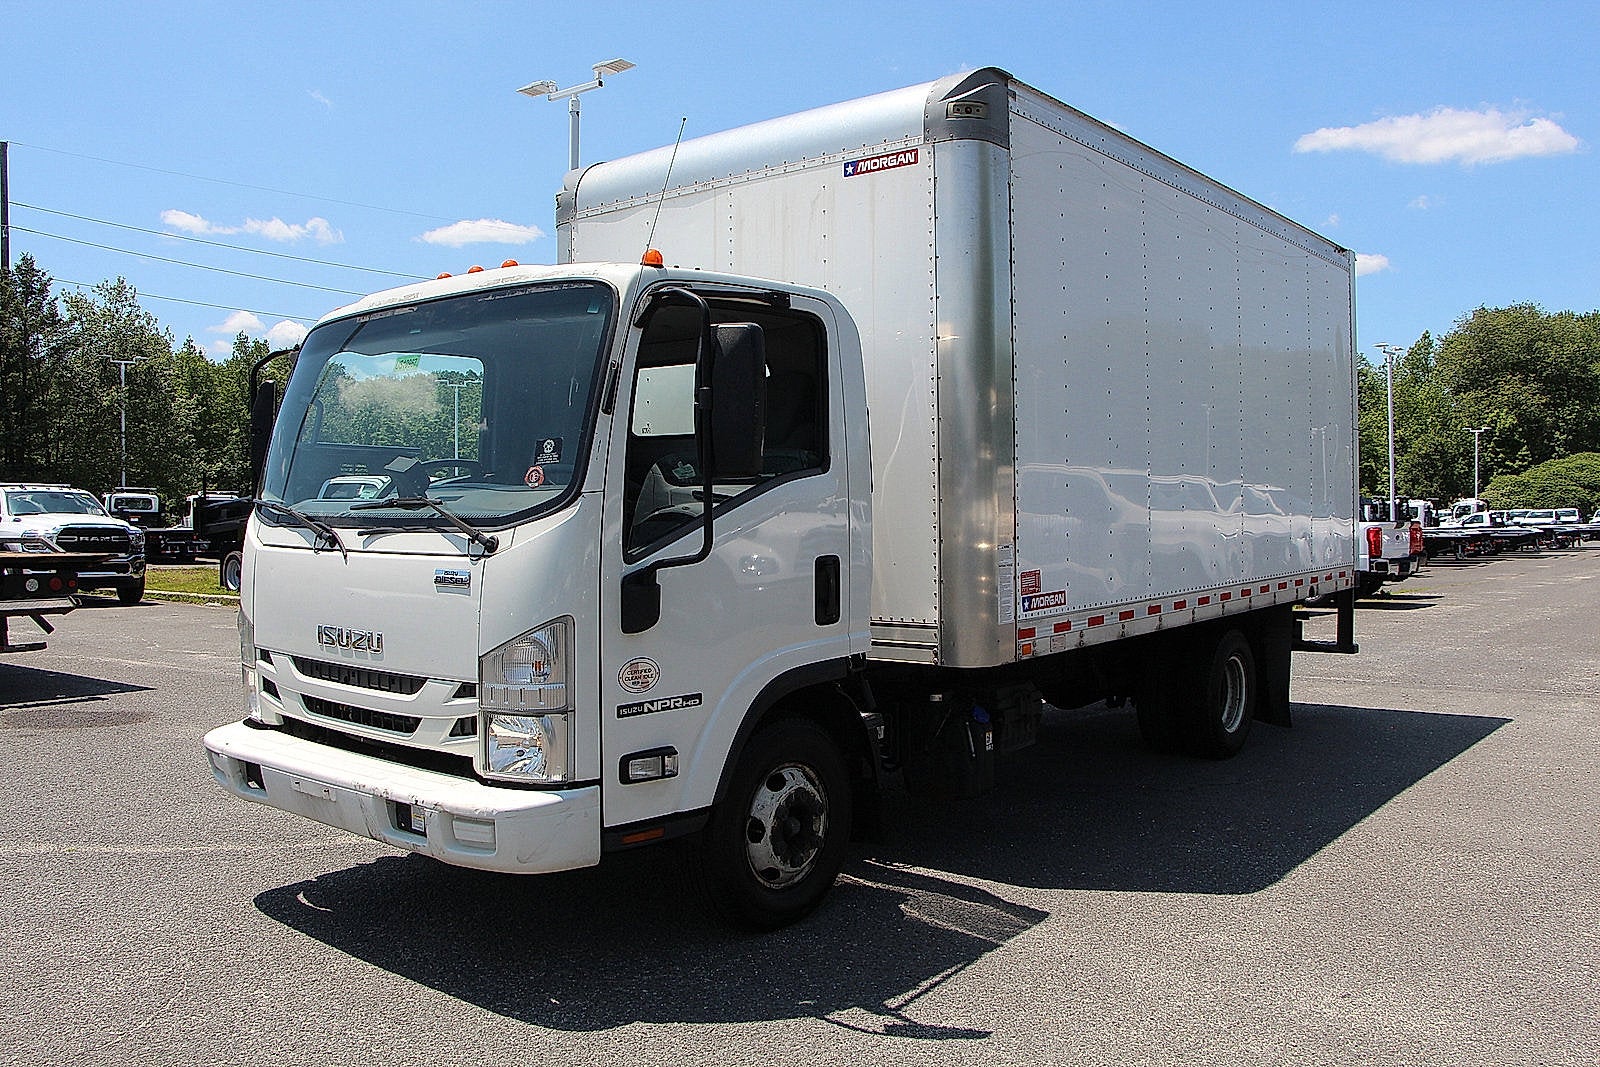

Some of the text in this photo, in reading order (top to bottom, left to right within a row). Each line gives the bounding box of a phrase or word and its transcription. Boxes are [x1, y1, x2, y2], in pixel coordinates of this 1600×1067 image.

[856, 151, 916, 173] MORGAN
[1030, 593, 1065, 609] MORGAN
[317, 624, 384, 654] ISUZU
[626, 668, 653, 676] CERTIFIED
[619, 706, 643, 715] ISUZU
[643, 697, 683, 713] NPR
